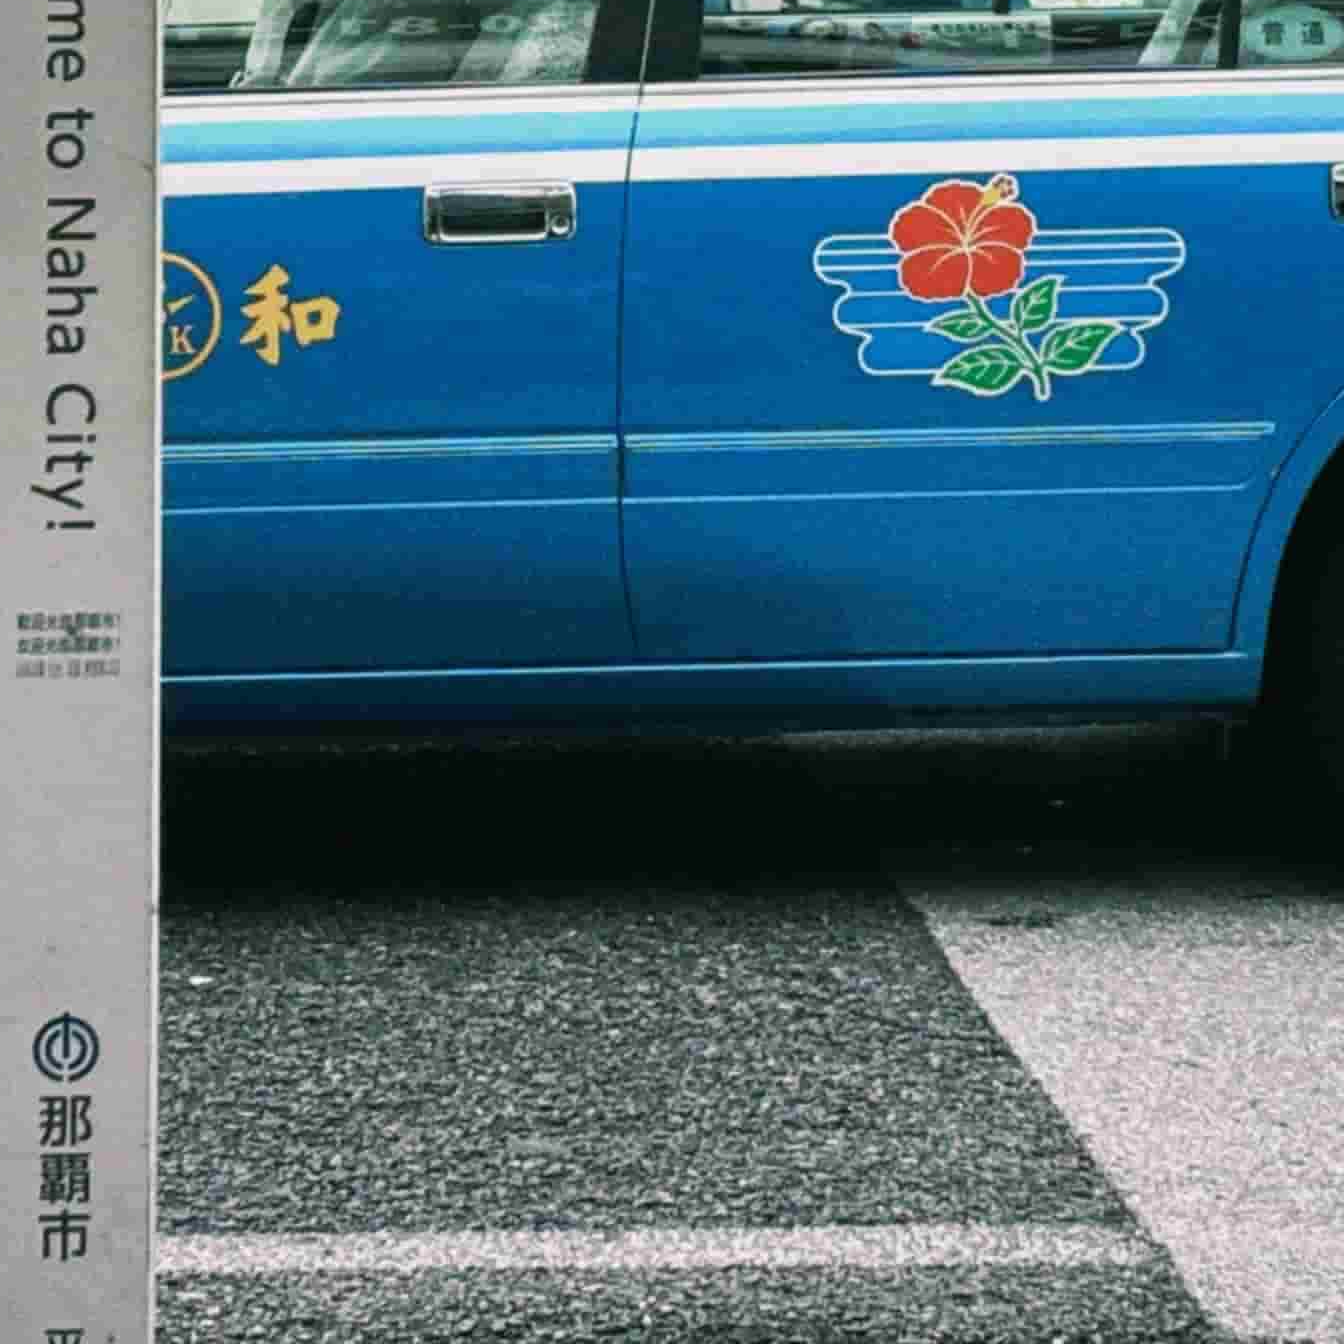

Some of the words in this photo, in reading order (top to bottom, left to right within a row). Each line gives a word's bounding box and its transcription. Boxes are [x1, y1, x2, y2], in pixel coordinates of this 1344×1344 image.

[46, 107, 94, 169] to
[46, 197, 98, 354] Naha
[239, 264, 340, 366] 和
[30, 382, 97, 529] City!
[39, 1095, 92, 1261] 那覇市
